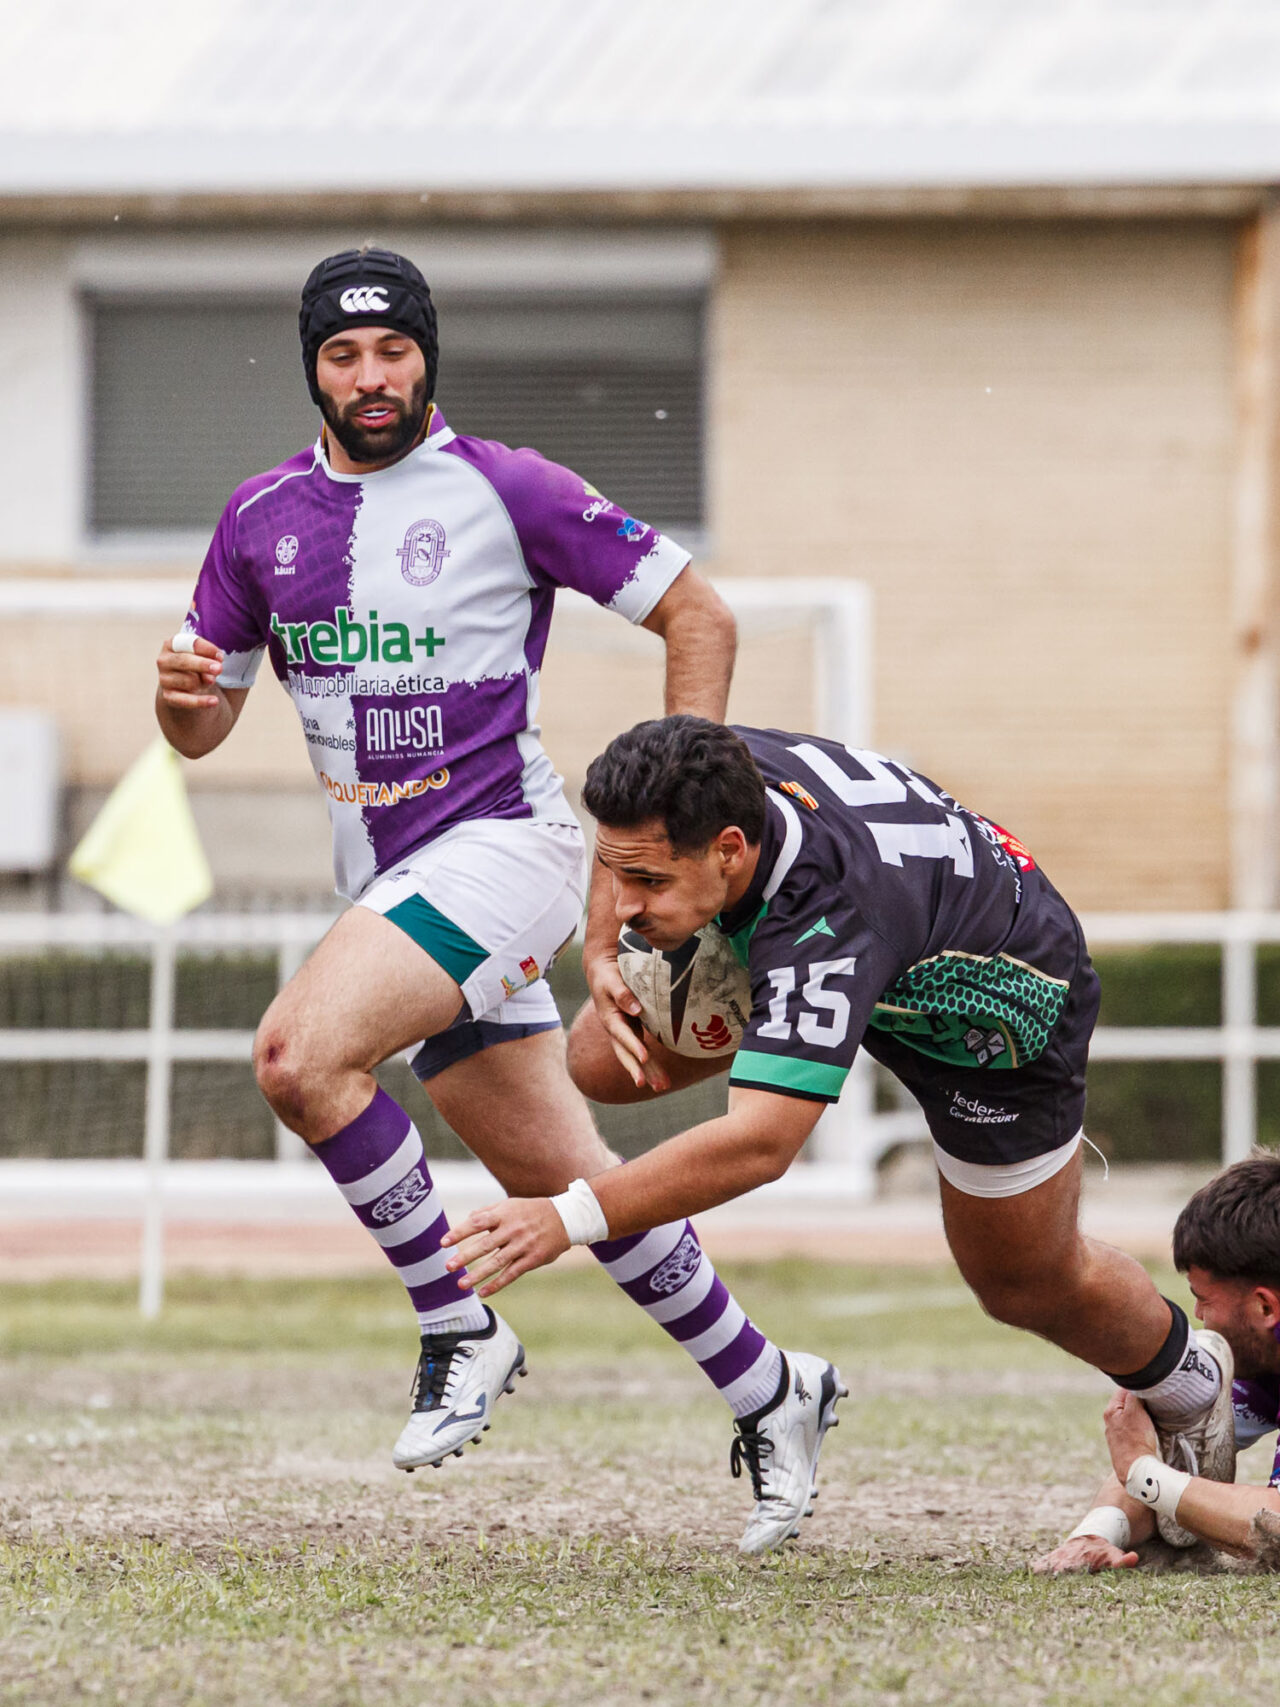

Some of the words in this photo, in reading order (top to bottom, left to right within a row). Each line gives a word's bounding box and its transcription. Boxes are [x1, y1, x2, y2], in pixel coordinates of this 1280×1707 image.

[418, 533, 432, 543] 25
[396, 674, 445, 692] ética
[366, 705, 444, 751] ANUSA
[785, 743, 975, 878] 15
[757, 957, 857, 1048] 15
